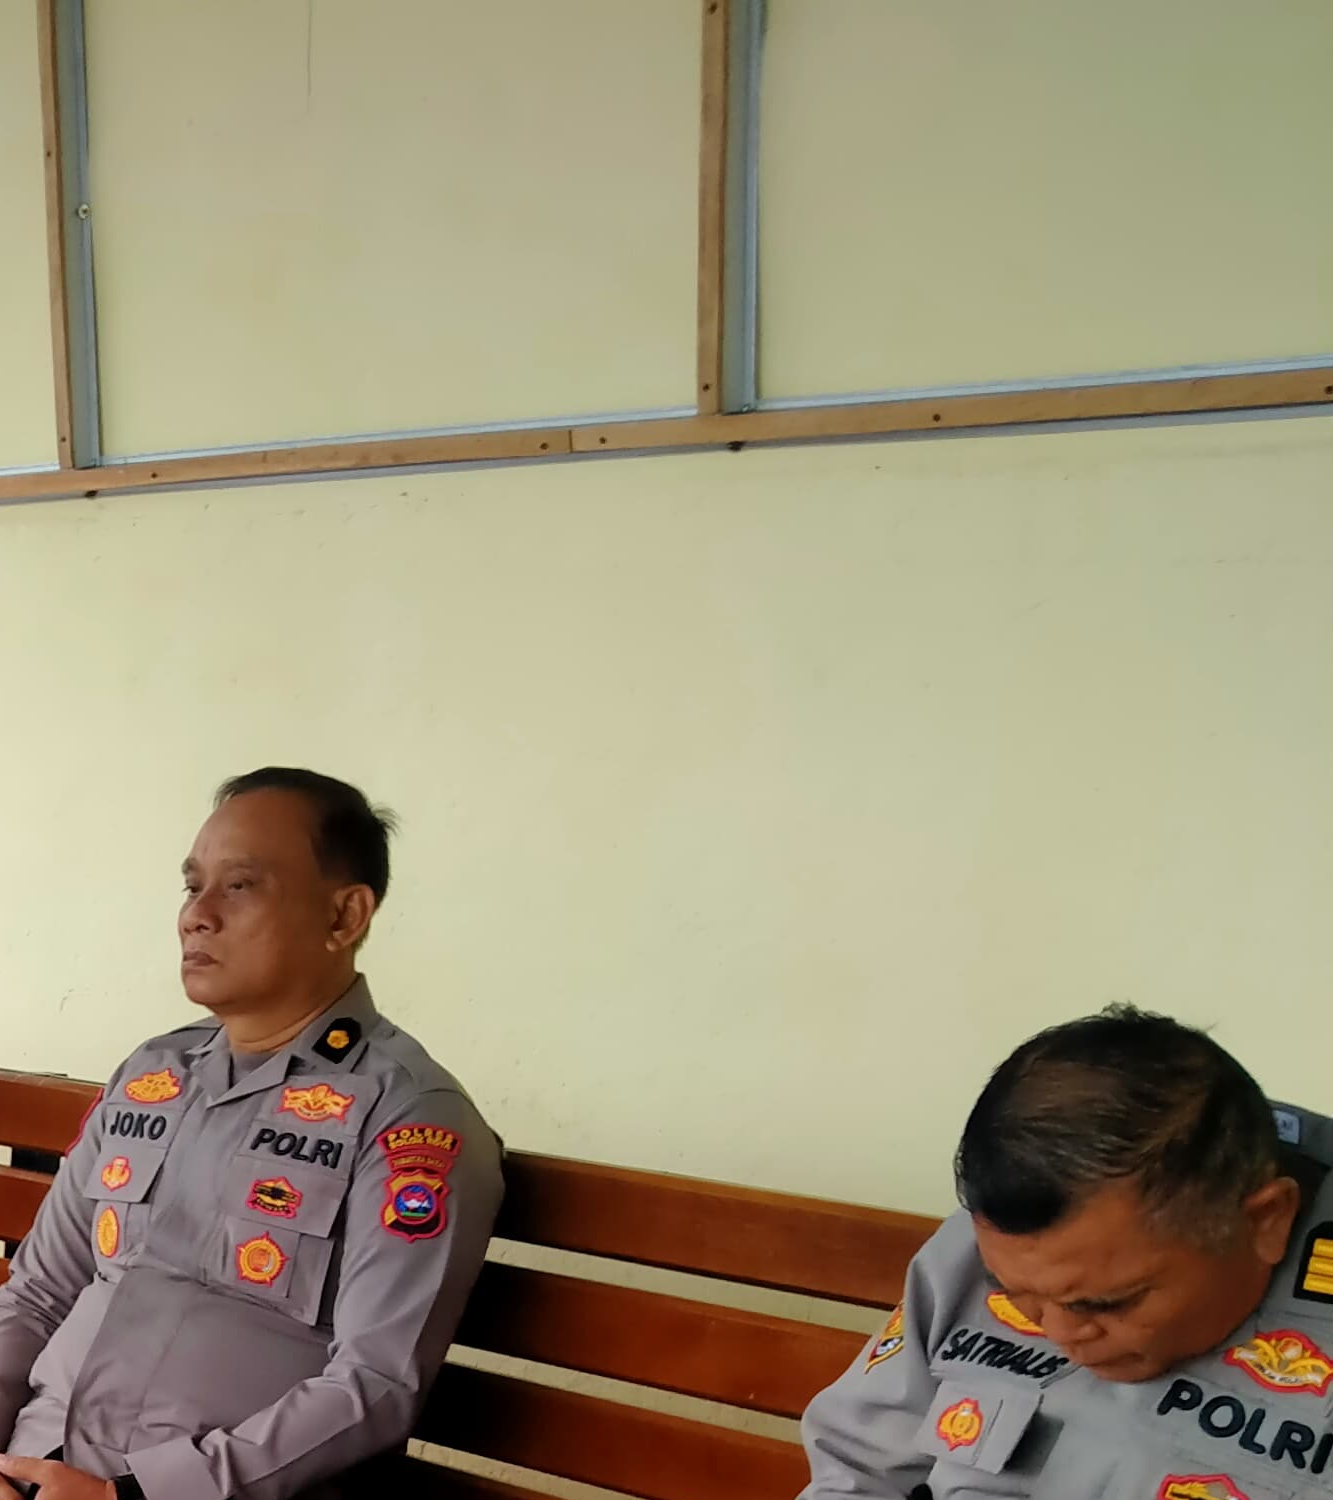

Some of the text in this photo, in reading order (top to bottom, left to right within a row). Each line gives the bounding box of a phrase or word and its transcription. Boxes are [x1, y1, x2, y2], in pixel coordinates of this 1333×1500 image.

[110, 1111, 167, 1140] JOKO
[250, 1128, 344, 1169] POLRI
[1157, 1378, 1333, 1474] POLRI
